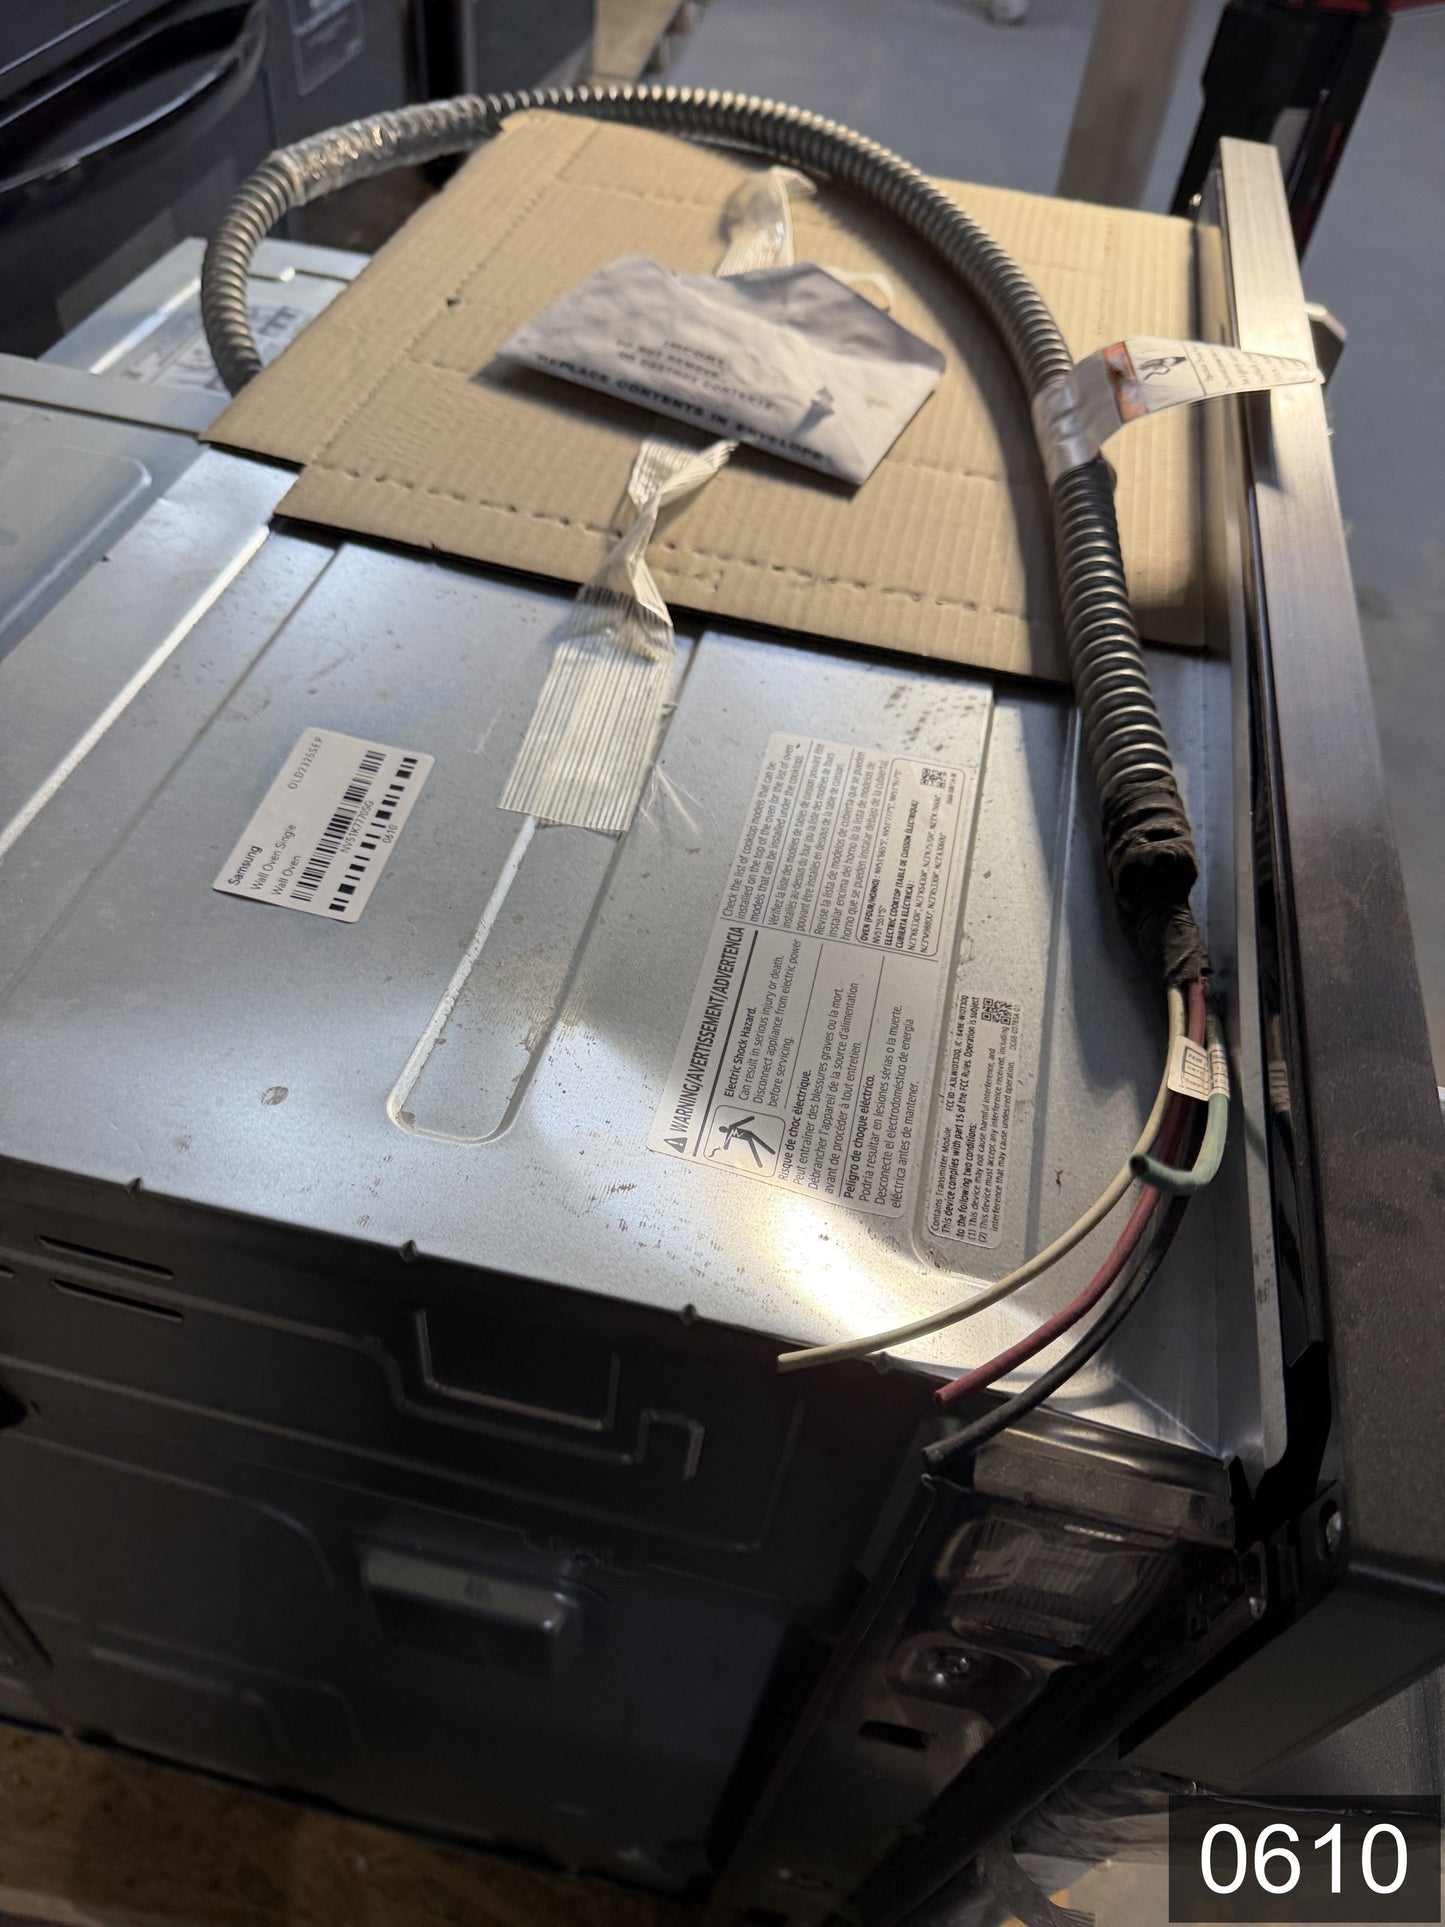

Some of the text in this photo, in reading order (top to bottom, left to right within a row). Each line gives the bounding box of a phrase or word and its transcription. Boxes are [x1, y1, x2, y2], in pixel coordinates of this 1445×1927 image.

[711, 412, 728, 425] IN
[782, 744, 793, 761] oven
[775, 769, 787, 780] list
[779, 760, 788, 769] of
[772, 781, 783, 793] the
[764, 805, 776, 823] oven
[339, 800, 374, 853] NV51K7770SG
[382, 824, 398, 844] 0610
[759, 823, 771, 836] the
[722, 761, 777, 917] Check the list of cooktop models that can be
[757, 836, 767, 845] of
[250, 824, 296, 890] Wall Oven Single
[753, 846, 766, 859] top
[227, 845, 263, 885] Samsung
[271, 855, 301, 895] Wall Oven
[748, 860, 761, 873] the
[746, 874, 757, 885] on
[734, 885, 754, 919] installed
[828, 1009, 839, 1018] la
[969, 996, 980, 1019] subject
[669, 927, 745, 1132] WARNING/AVERTISSEMENT/ADVERTENCIA
[738, 955, 784, 1101] Can result in serious injury or death.
[752, 938, 801, 1104] Disconnect appliance from electric power
[827, 1019, 837, 1031] ou
[889, 1005, 902, 1036] muerte.
[723, 1007, 757, 1098] Electric Shock Hazard.
[820, 1031, 834, 1061] graves
[885, 1037, 896, 1046] la
[963, 1026, 975, 1058] Operation
[988, 1047, 996, 1061] and
[766, 1036, 794, 1107] before servicing.
[880, 1054, 894, 1080] sérias
[807, 982, 858, 1190] Débrancher l'appareil de la source d'alimentation
[809, 1061, 828, 1102] blessures
[841, 1083, 854, 1101] tout
[959, 1078, 969, 1091] FCC
[872, 1081, 889, 1117] lesiones
[945, 1099, 955, 1111] FCC
[947, 1091, 955, 1099] ID
[957, 1092, 967, 1104] the
[806, 1103, 819, 1120] des
[874, 1018, 915, 1205] Desconecte el electrodoméstico de energía
[955, 1113, 964, 1123] 15
[956, 1103, 965, 1113] of
[979, 1103, 989, 1131] harmful
[1001, 1094, 1011, 1129] undesired
[778, 1069, 812, 1179] Risque de choc électrique.
[832, 1110, 848, 1152] procéder
[872, 1118, 882, 1130] en
[954, 1124, 963, 1140] part
[978, 1026, 1010, 1243] (2) This device must accept any interference received, including
[843, 1074, 875, 1199] Peligro de choque eléctrico.
[890, 1081, 919, 1208] eléctrica antes de mantener.
[941, 1126, 951, 1153] Module
[978, 1132, 986, 1153] cause
[999, 1130, 1008, 1150] cause
[828, 1153, 840, 1165] de
[866, 1131, 880, 1168] resultar
[951, 1140, 961, 1156] with
[997, 1151, 1007, 1167] may
[976, 1153, 984, 1166] not
[792, 1165, 806, 1185] Peut
[824, 1167, 837, 1194] avant
[935, 1154, 948, 1196] Transmitter
[947, 1157, 959, 1190] complies
[955, 1122, 977, 1237] to the following two conditions:
[974, 1167, 984, 1183] may
[995, 1168, 1004, 1184] that
[858, 1170, 874, 1202] Podría
[970, 1184, 981, 1210] device
[943, 1190, 955, 1216] device
[990, 1184, 1002, 1232] interference
[930, 1198, 943, 1231] Contains
[941, 1217, 952, 1233] This
[968, 1211, 978, 1226] This
[967, 1228, 976, 1240] (1)
